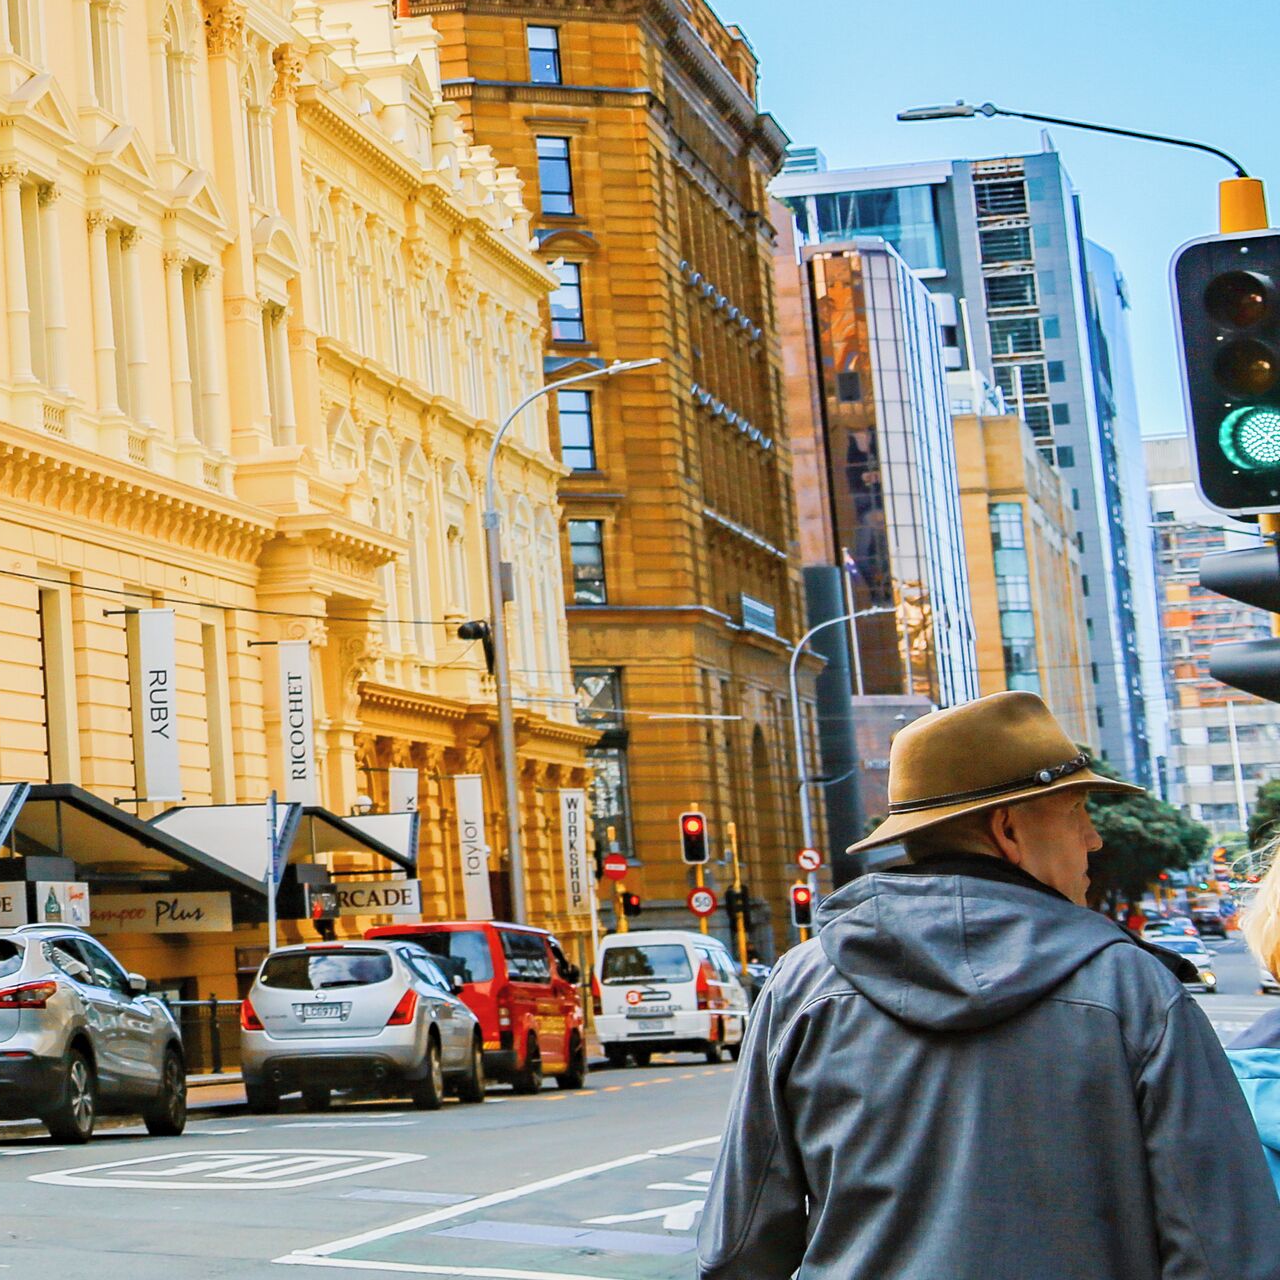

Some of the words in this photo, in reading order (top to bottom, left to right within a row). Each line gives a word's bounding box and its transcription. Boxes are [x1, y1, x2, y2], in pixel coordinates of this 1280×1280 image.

[148, 669, 171, 741] RUBY
[286, 671, 306, 782] RICOCHET
[462, 819, 481, 878] taylor
[566, 797, 582, 909] WORKSHOP
[155, 898, 205, 927] Plus
[337, 888, 413, 908] RCADE
[694, 896, 712, 908] 50
